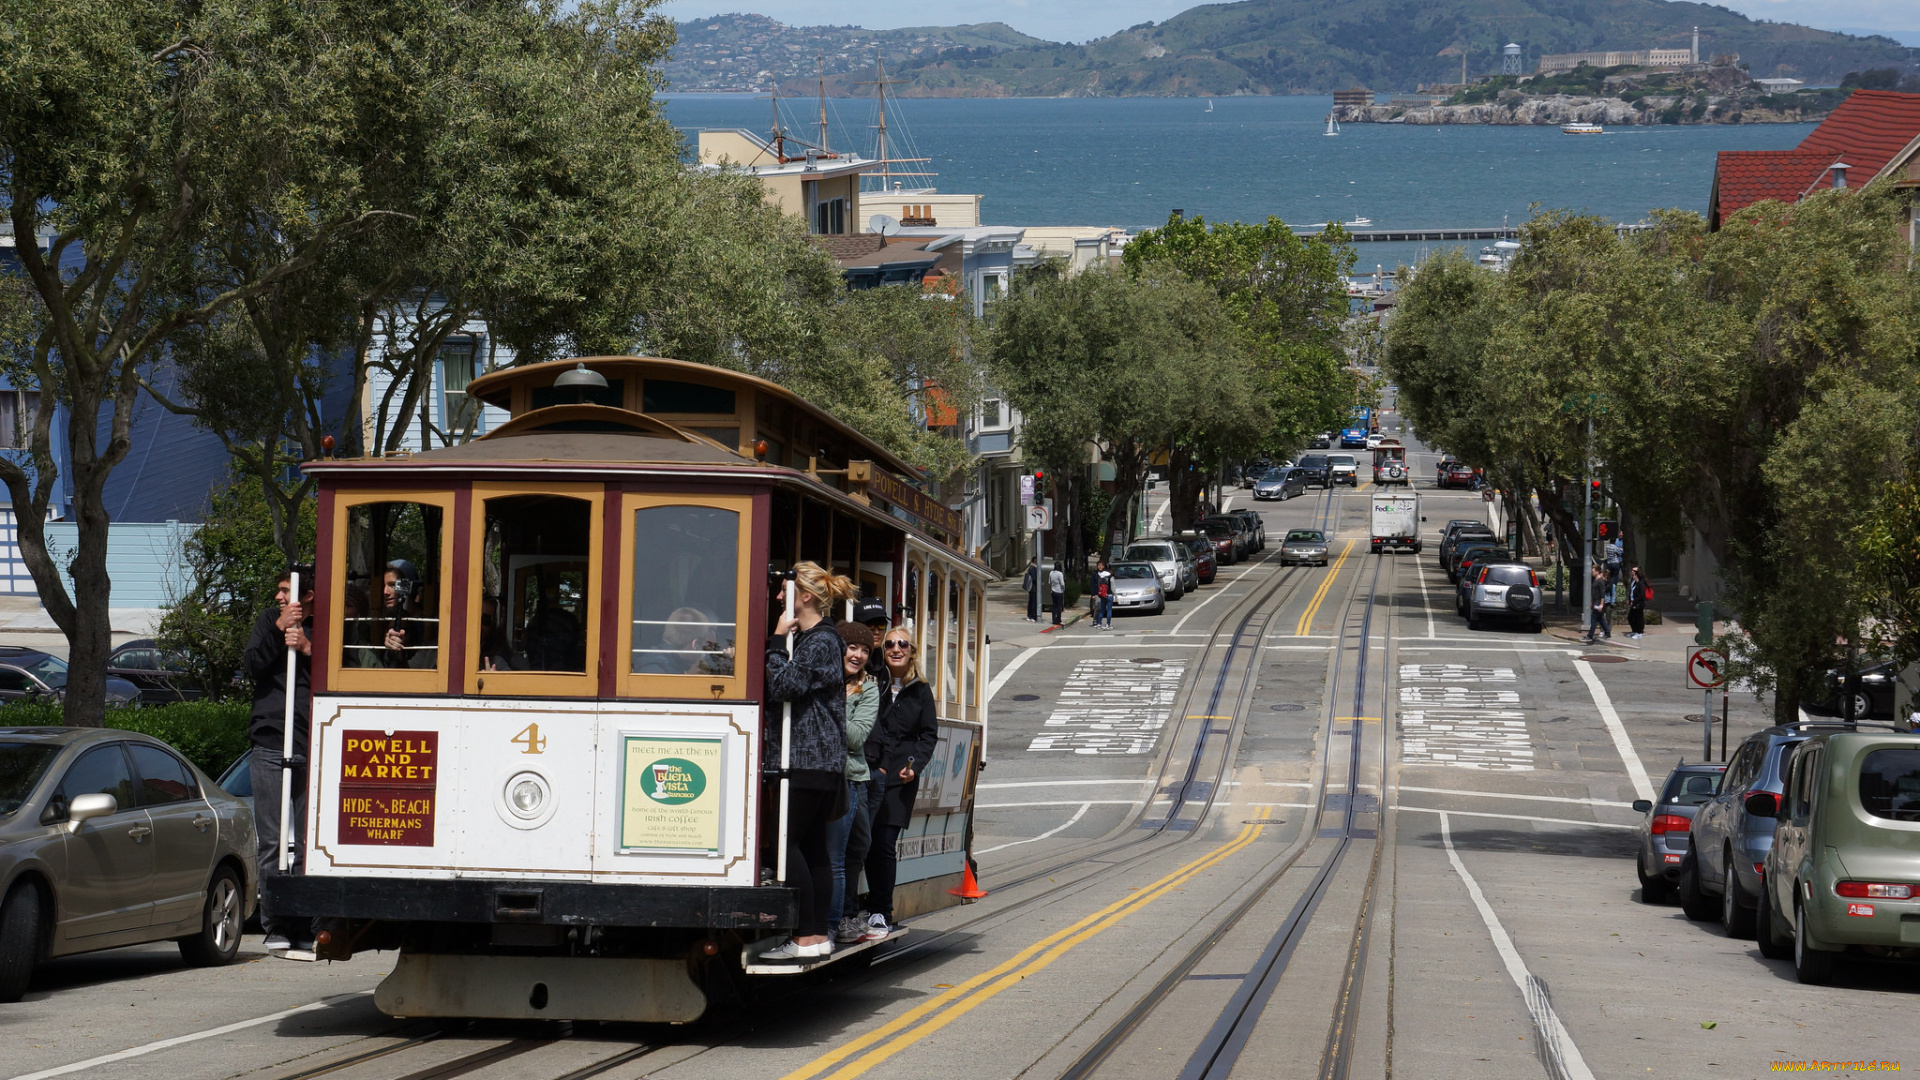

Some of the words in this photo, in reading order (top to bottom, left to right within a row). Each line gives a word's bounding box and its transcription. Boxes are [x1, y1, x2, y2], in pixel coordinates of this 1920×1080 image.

[873, 471, 908, 506] POWELL
[914, 493, 920, 511] &
[924, 499, 944, 524] HYDE
[510, 722, 547, 754] 4
[347, 739, 432, 753] POWELL
[368, 754, 412, 764] AND
[344, 765, 432, 779] MARKET
[669, 765, 682, 773] the
[343, 798, 372, 814] HYDE
[376, 799, 389, 814] AND
[391, 798, 430, 814] BEACH
[350, 817, 422, 829] FISHERMANS
[367, 829, 405, 840] WHARF
